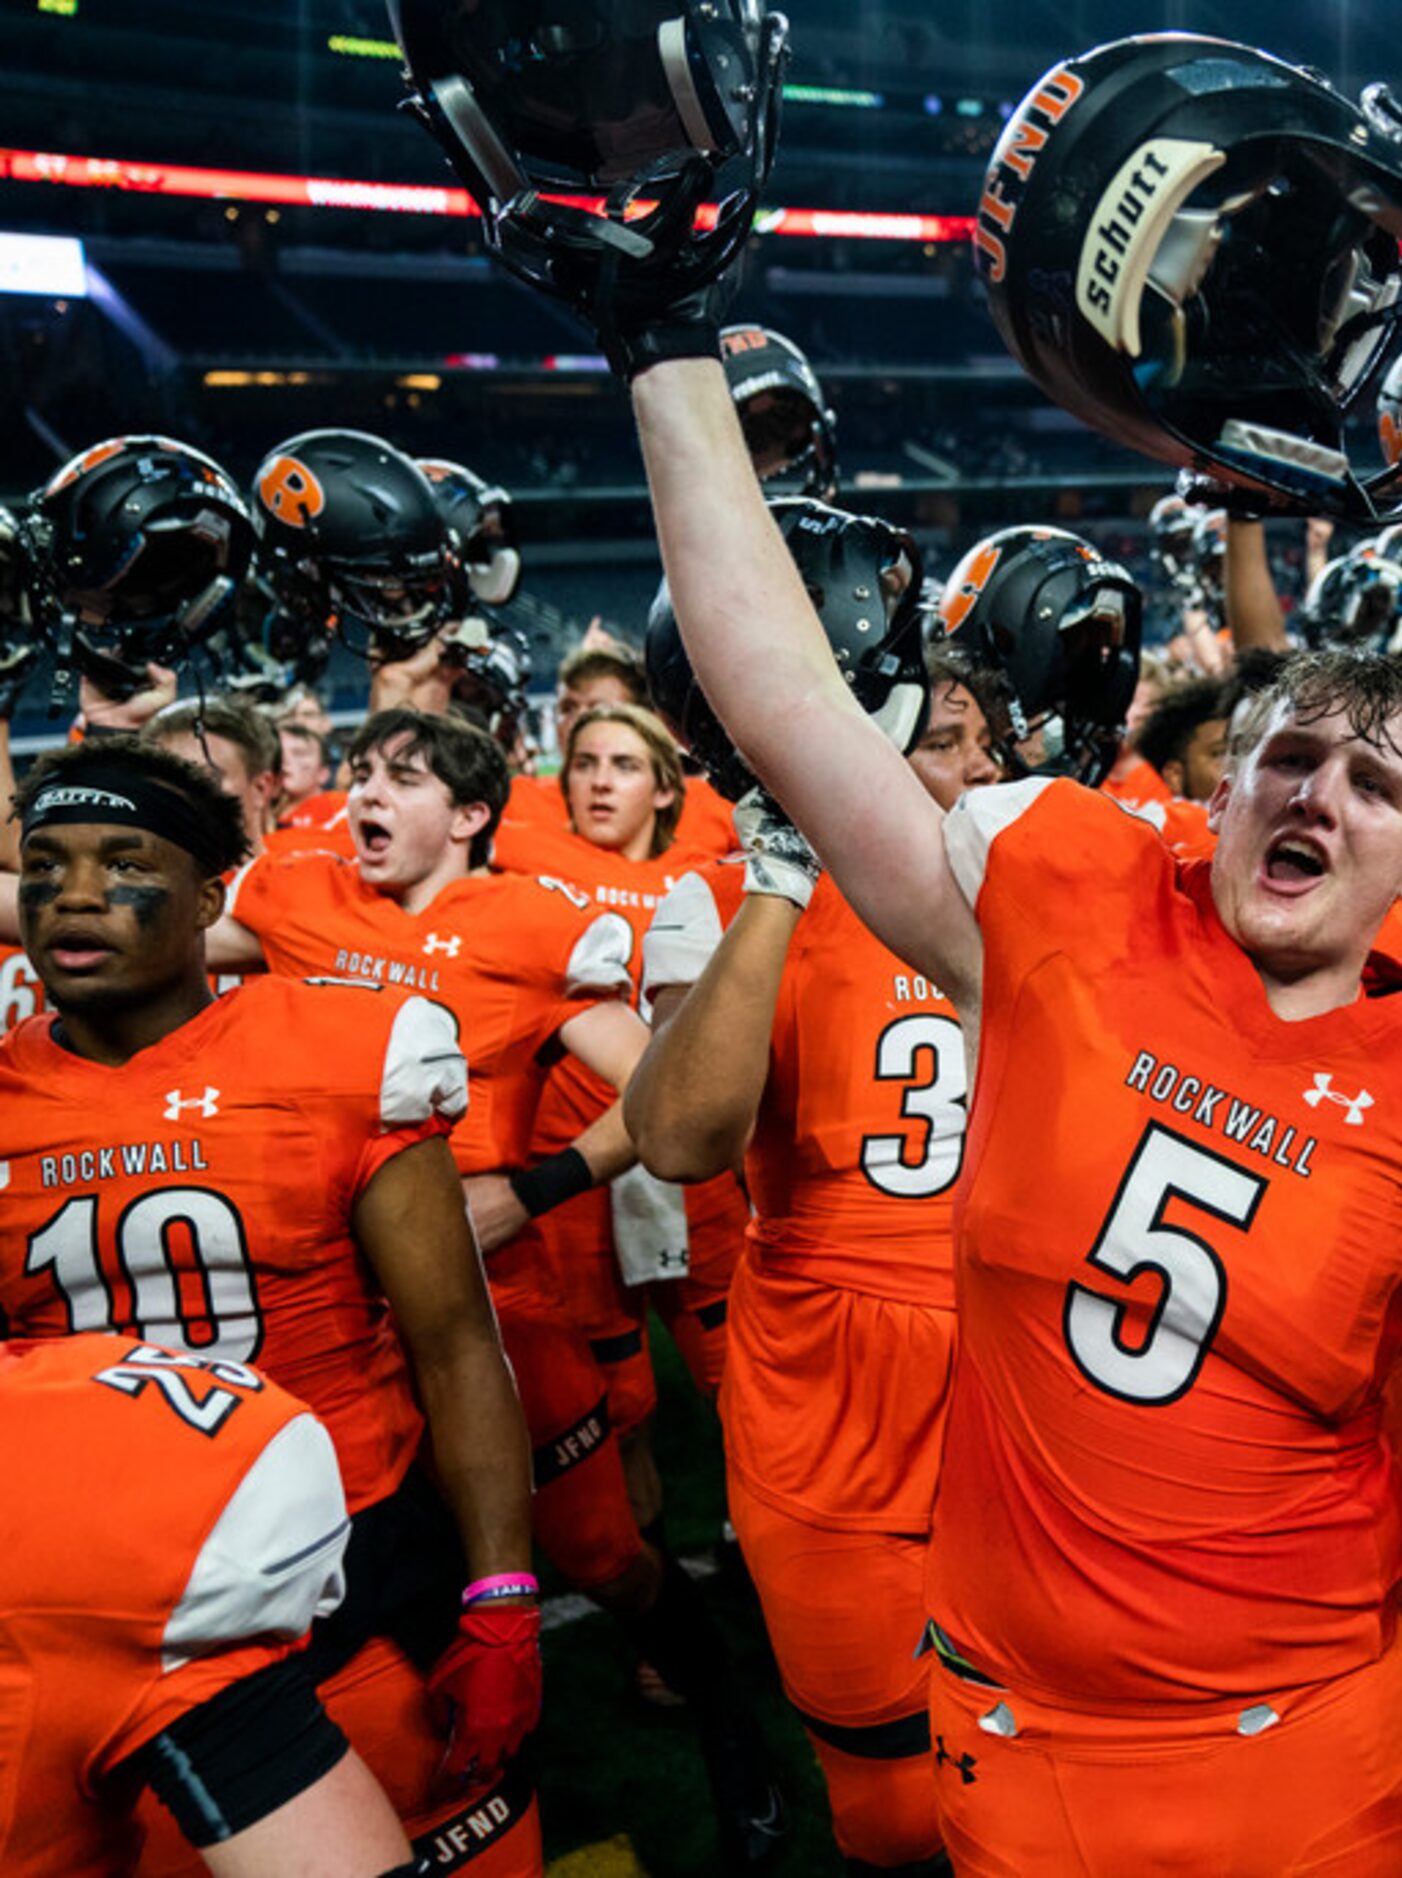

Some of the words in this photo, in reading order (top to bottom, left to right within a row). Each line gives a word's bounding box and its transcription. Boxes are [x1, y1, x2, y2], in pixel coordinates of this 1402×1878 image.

[976, 69, 1086, 283] JFND
[1086, 151, 1169, 316] schutt
[334, 948, 440, 992] ROCKWALL
[40, 1139, 209, 1189] ROCKWALL
[1125, 1049, 1318, 1178] ROCKWALL
[23, 1184, 266, 1365] 10
[1062, 1117, 1270, 1408] 5
[433, 1795, 511, 1864] JFND
